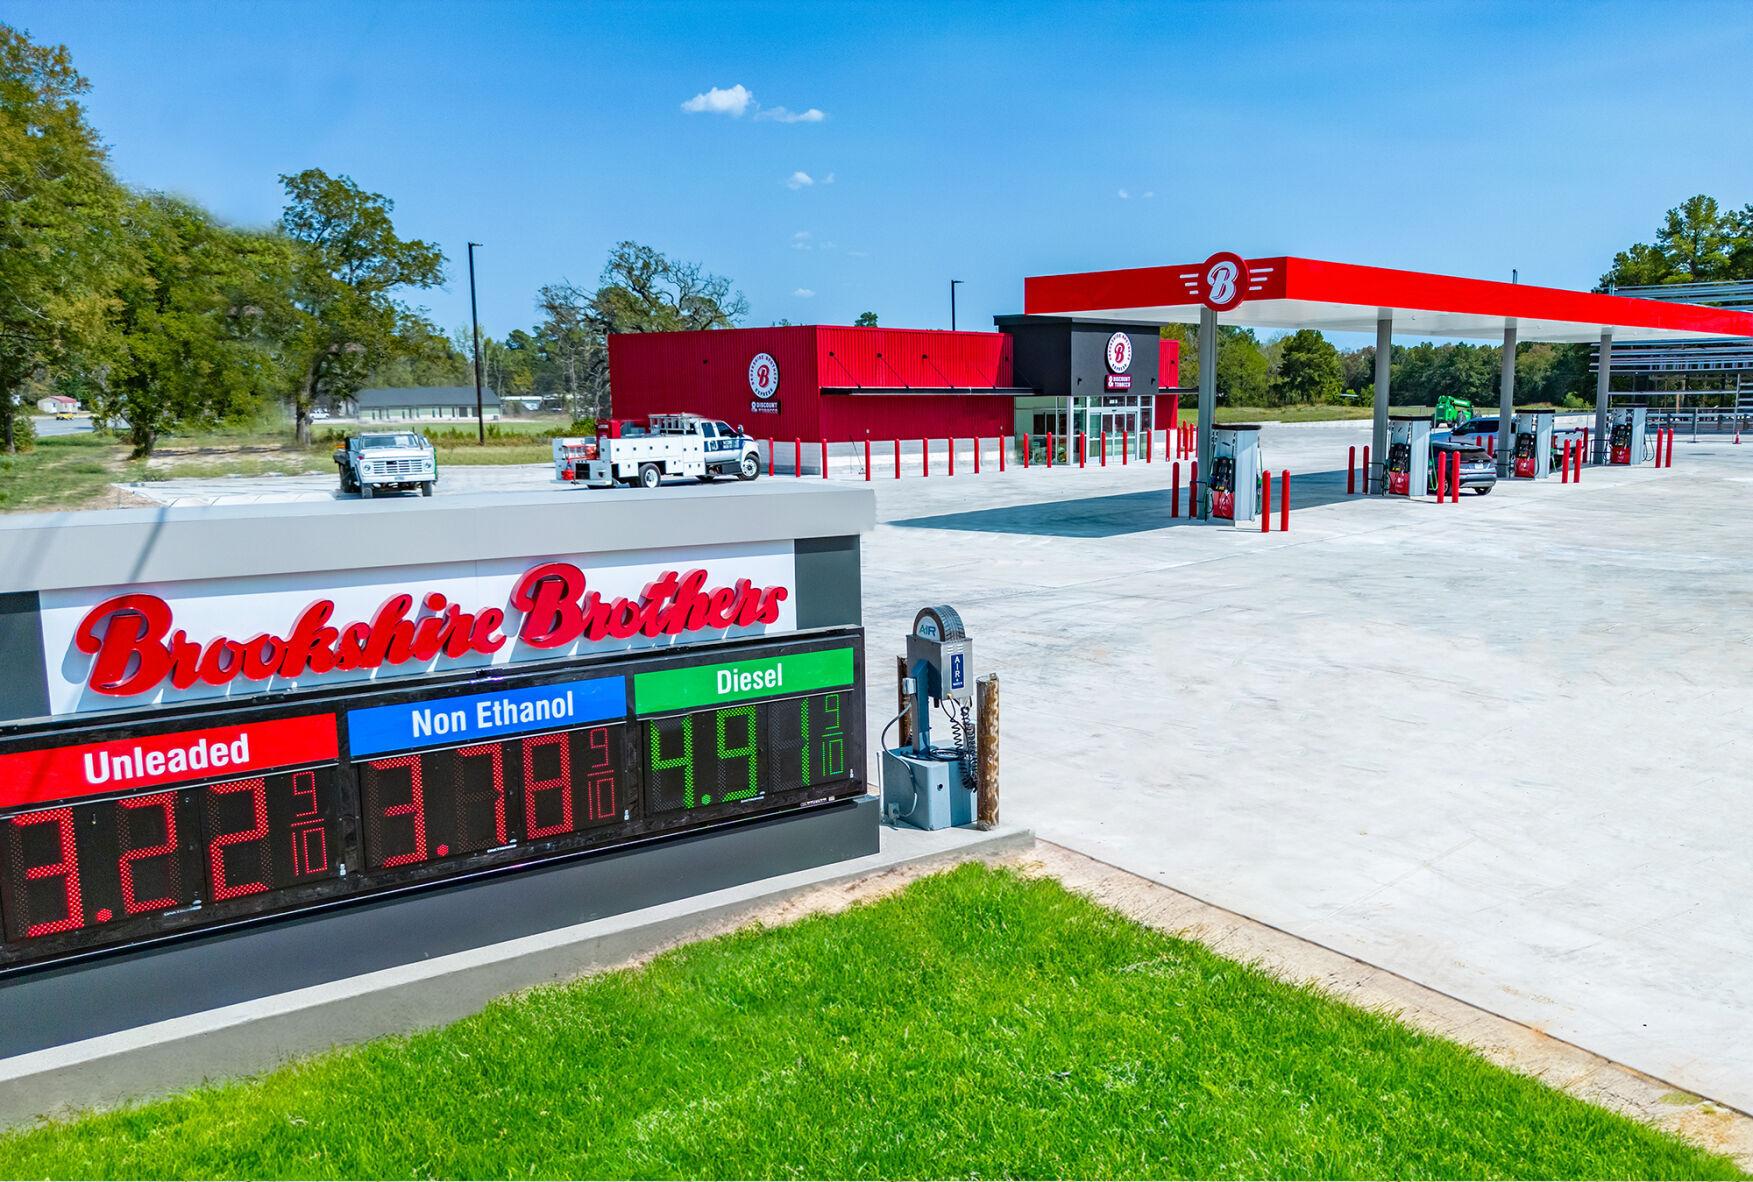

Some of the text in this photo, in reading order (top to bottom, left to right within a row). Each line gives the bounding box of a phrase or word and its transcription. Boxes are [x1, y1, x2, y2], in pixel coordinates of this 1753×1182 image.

[1207, 261, 1238, 304] B
[74, 562, 789, 698] Brookshire Brothers
[919, 624, 936, 637] AIR
[716, 663, 783, 695] Diesel
[411, 690, 575, 738] Non Ethanol
[84, 732, 250, 784] Unleaded
